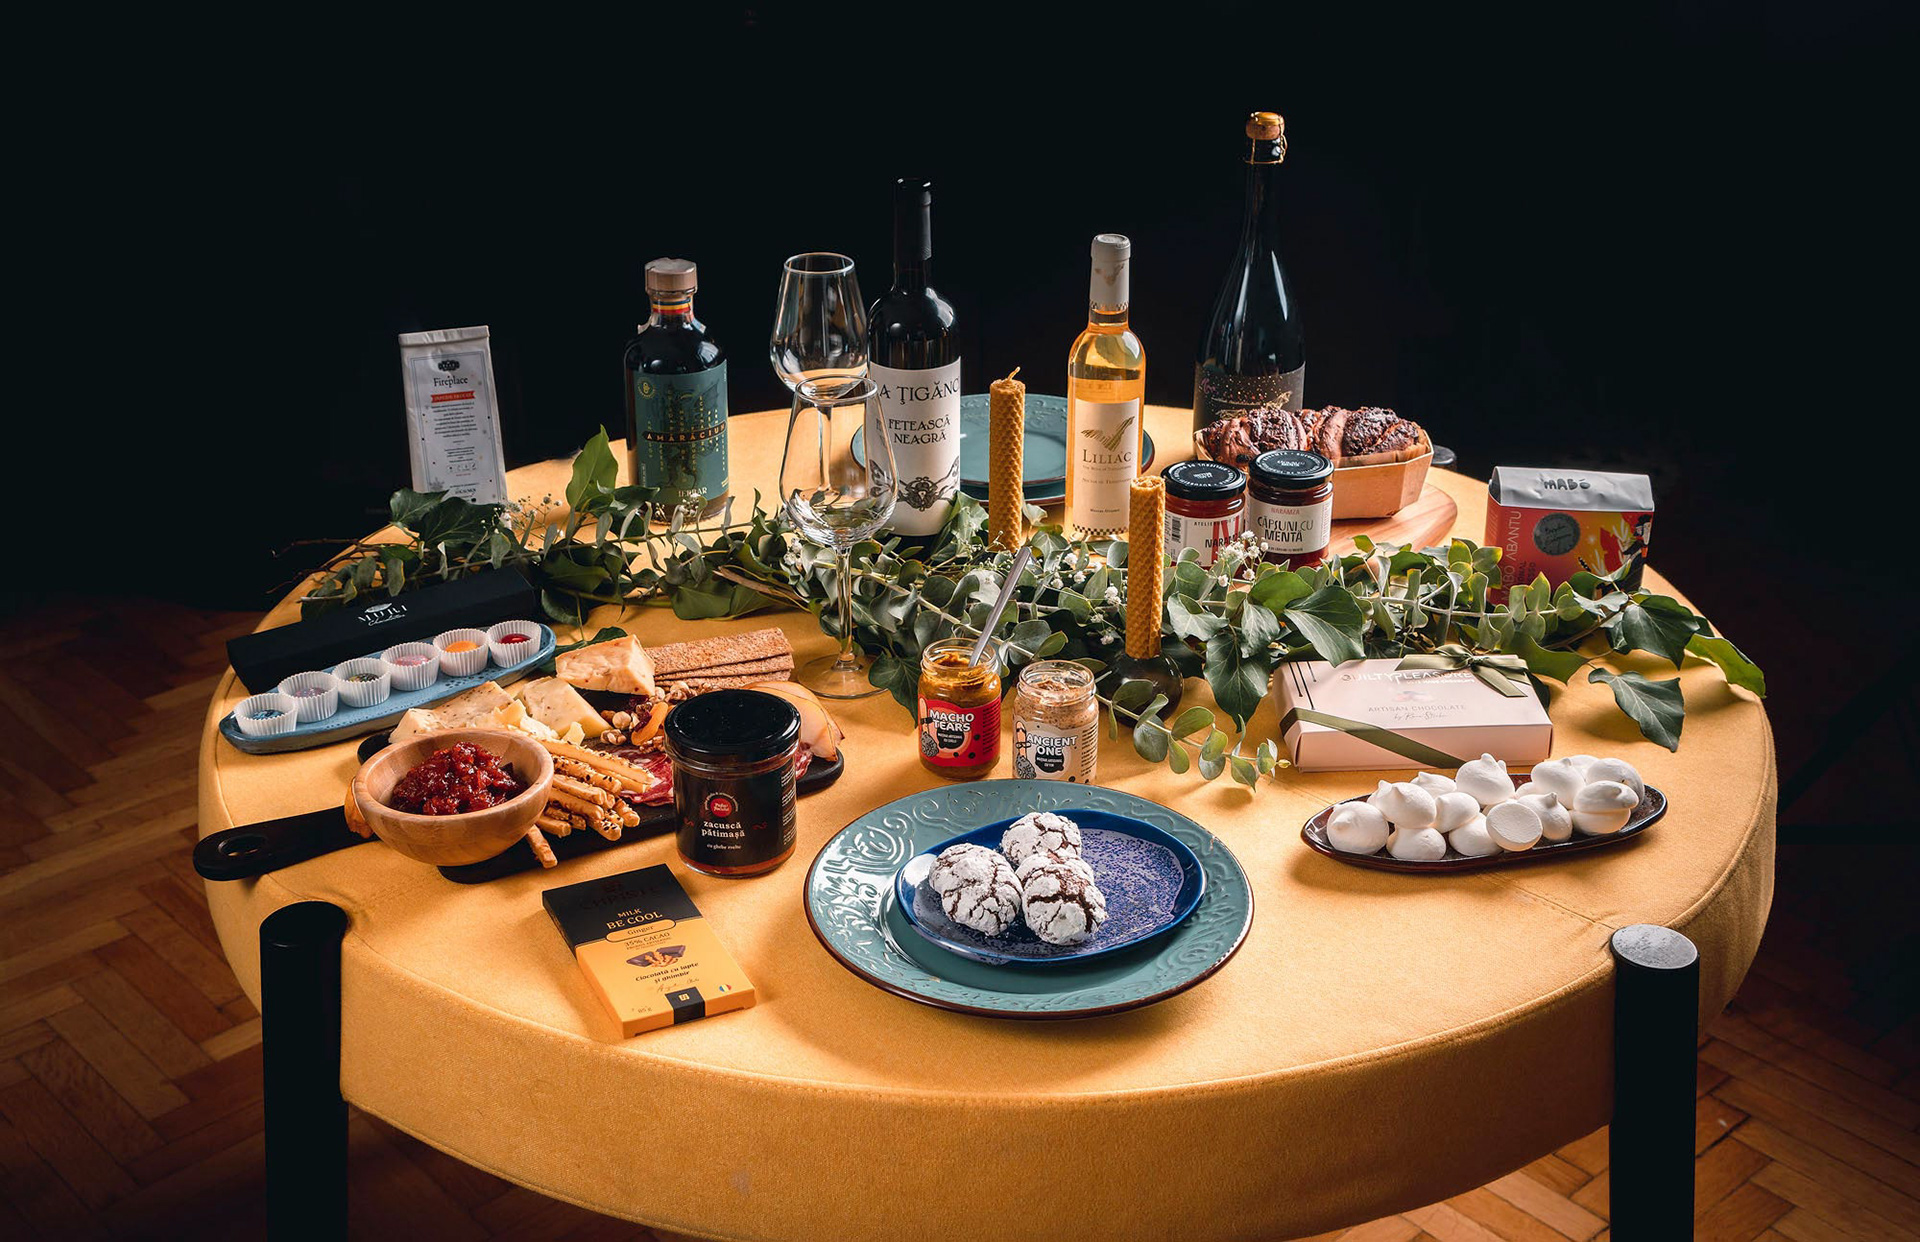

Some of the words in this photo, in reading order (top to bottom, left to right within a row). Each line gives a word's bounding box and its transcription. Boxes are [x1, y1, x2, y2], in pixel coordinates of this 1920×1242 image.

[433, 375, 468, 388] Fireplace
[889, 414, 950, 431] FETEASCĂ
[894, 429, 946, 445] NEAGRĂ
[1300, 519, 1314, 532] CU
[1264, 529, 1303, 543] MENTĂ
[1505, 510, 1522, 561] ABANTU
[1368, 705, 1408, 713] ARTISAN
[1411, 704, 1466, 712] CHOCOLATE
[929, 709, 975, 723] MACHO
[932, 719, 971, 732] TEARS
[1026, 733, 1078, 747] ANCIENT
[1036, 745, 1062, 756] ONE
[703, 821, 742, 829] zacuscă
[617, 908, 642, 918] MILK
[606, 919, 625, 930] BE
[626, 911, 663, 925] COOL
[627, 925, 654, 936] Ginger
[643, 931, 670, 942] CACAO
[680, 962, 699, 971] lapte
[662, 970, 690, 982] ghimbir
